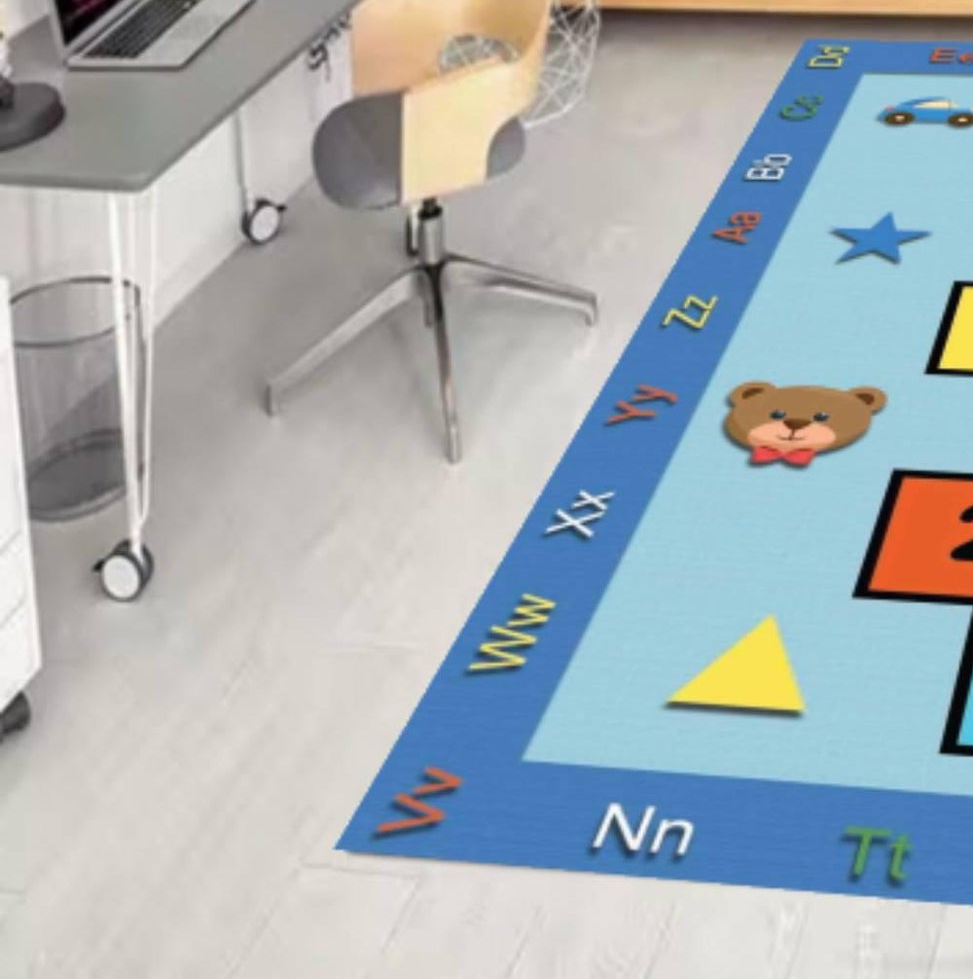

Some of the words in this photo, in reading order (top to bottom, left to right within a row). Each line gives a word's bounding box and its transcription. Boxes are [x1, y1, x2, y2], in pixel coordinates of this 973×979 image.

[745, 153, 792, 181] Bb
[712, 210, 763, 243] Aa
[663, 294, 718, 330] Zz
[604, 384, 678, 424] Yy
[545, 488, 615, 539] Xx
[467, 592, 556, 674] Ww
[376, 766, 464, 834] Vv
[593, 802, 695, 856] Nn
[845, 825, 913, 881] Tt
